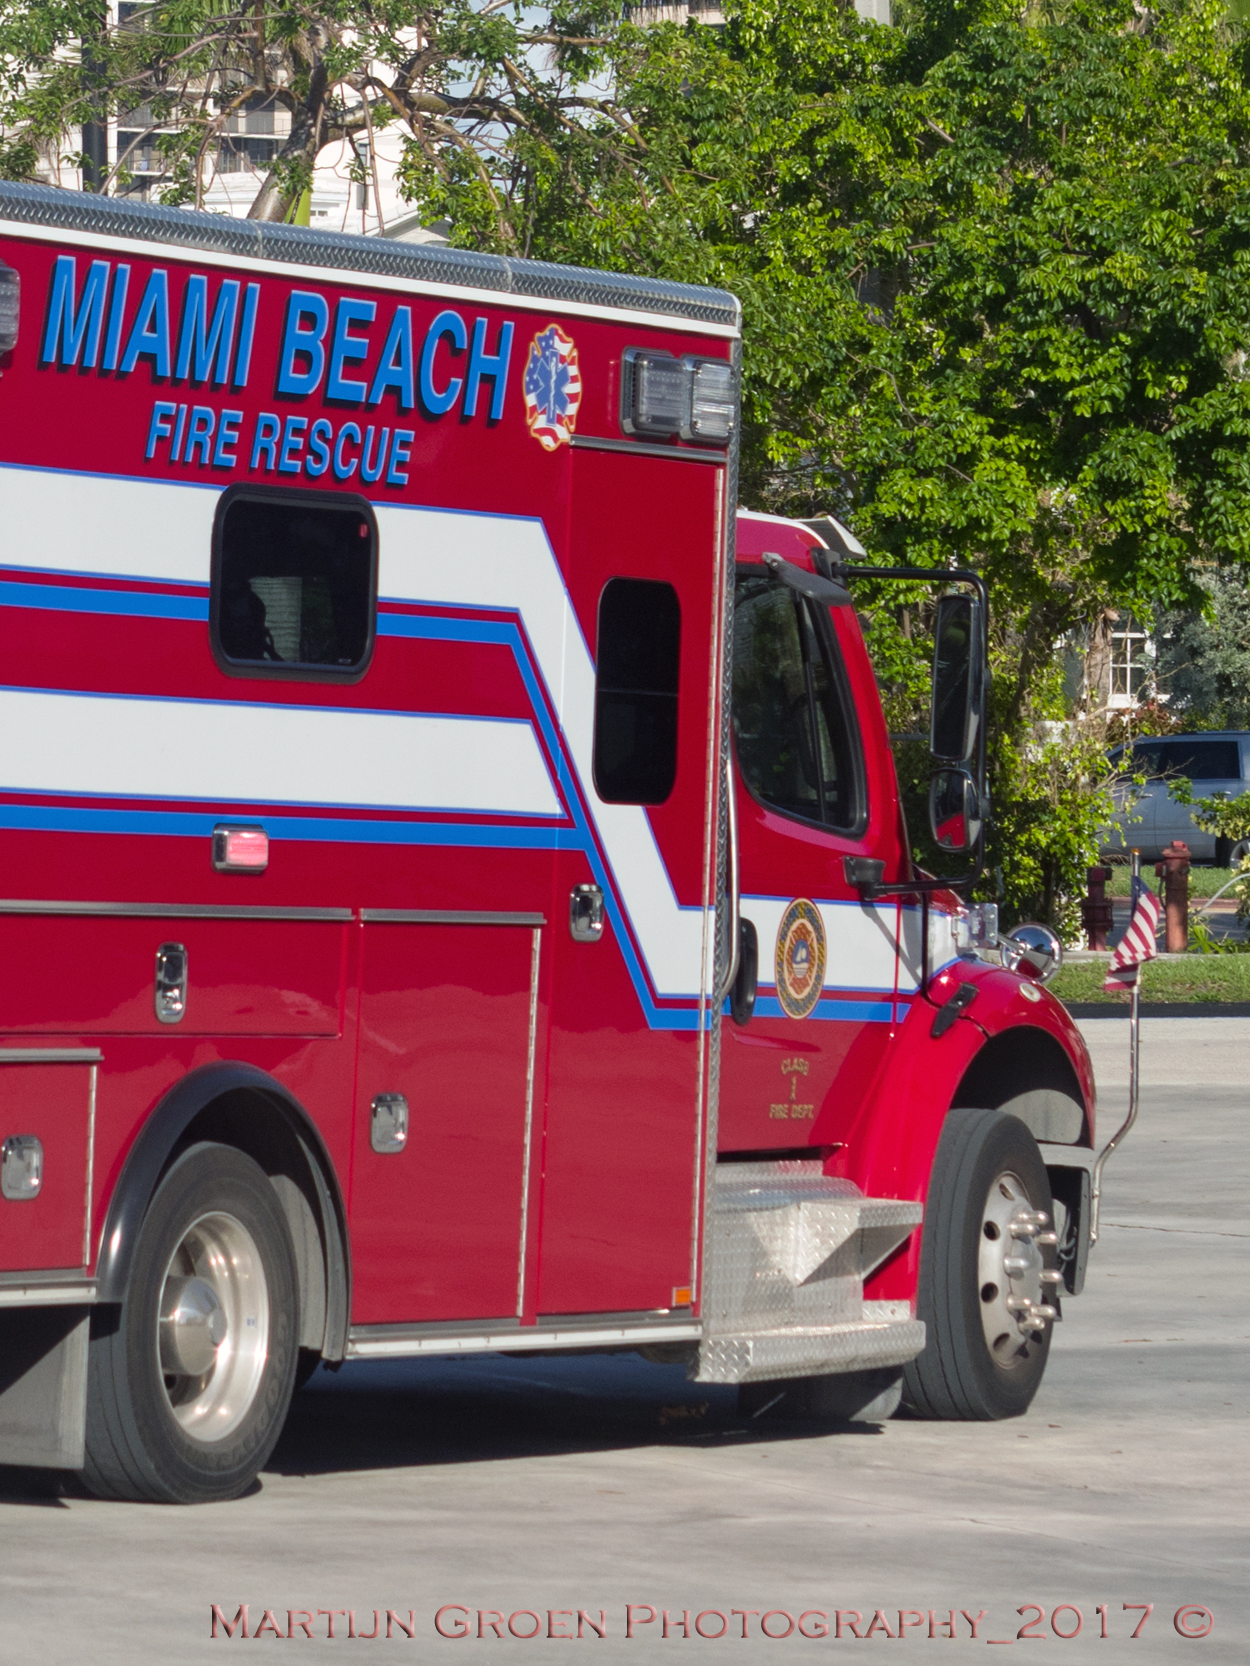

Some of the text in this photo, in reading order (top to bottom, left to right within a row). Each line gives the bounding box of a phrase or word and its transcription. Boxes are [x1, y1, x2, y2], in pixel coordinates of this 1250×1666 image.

[40, 254, 516, 422] MIAMI BEACH
[145, 400, 416, 486] FIRE RESCUE
